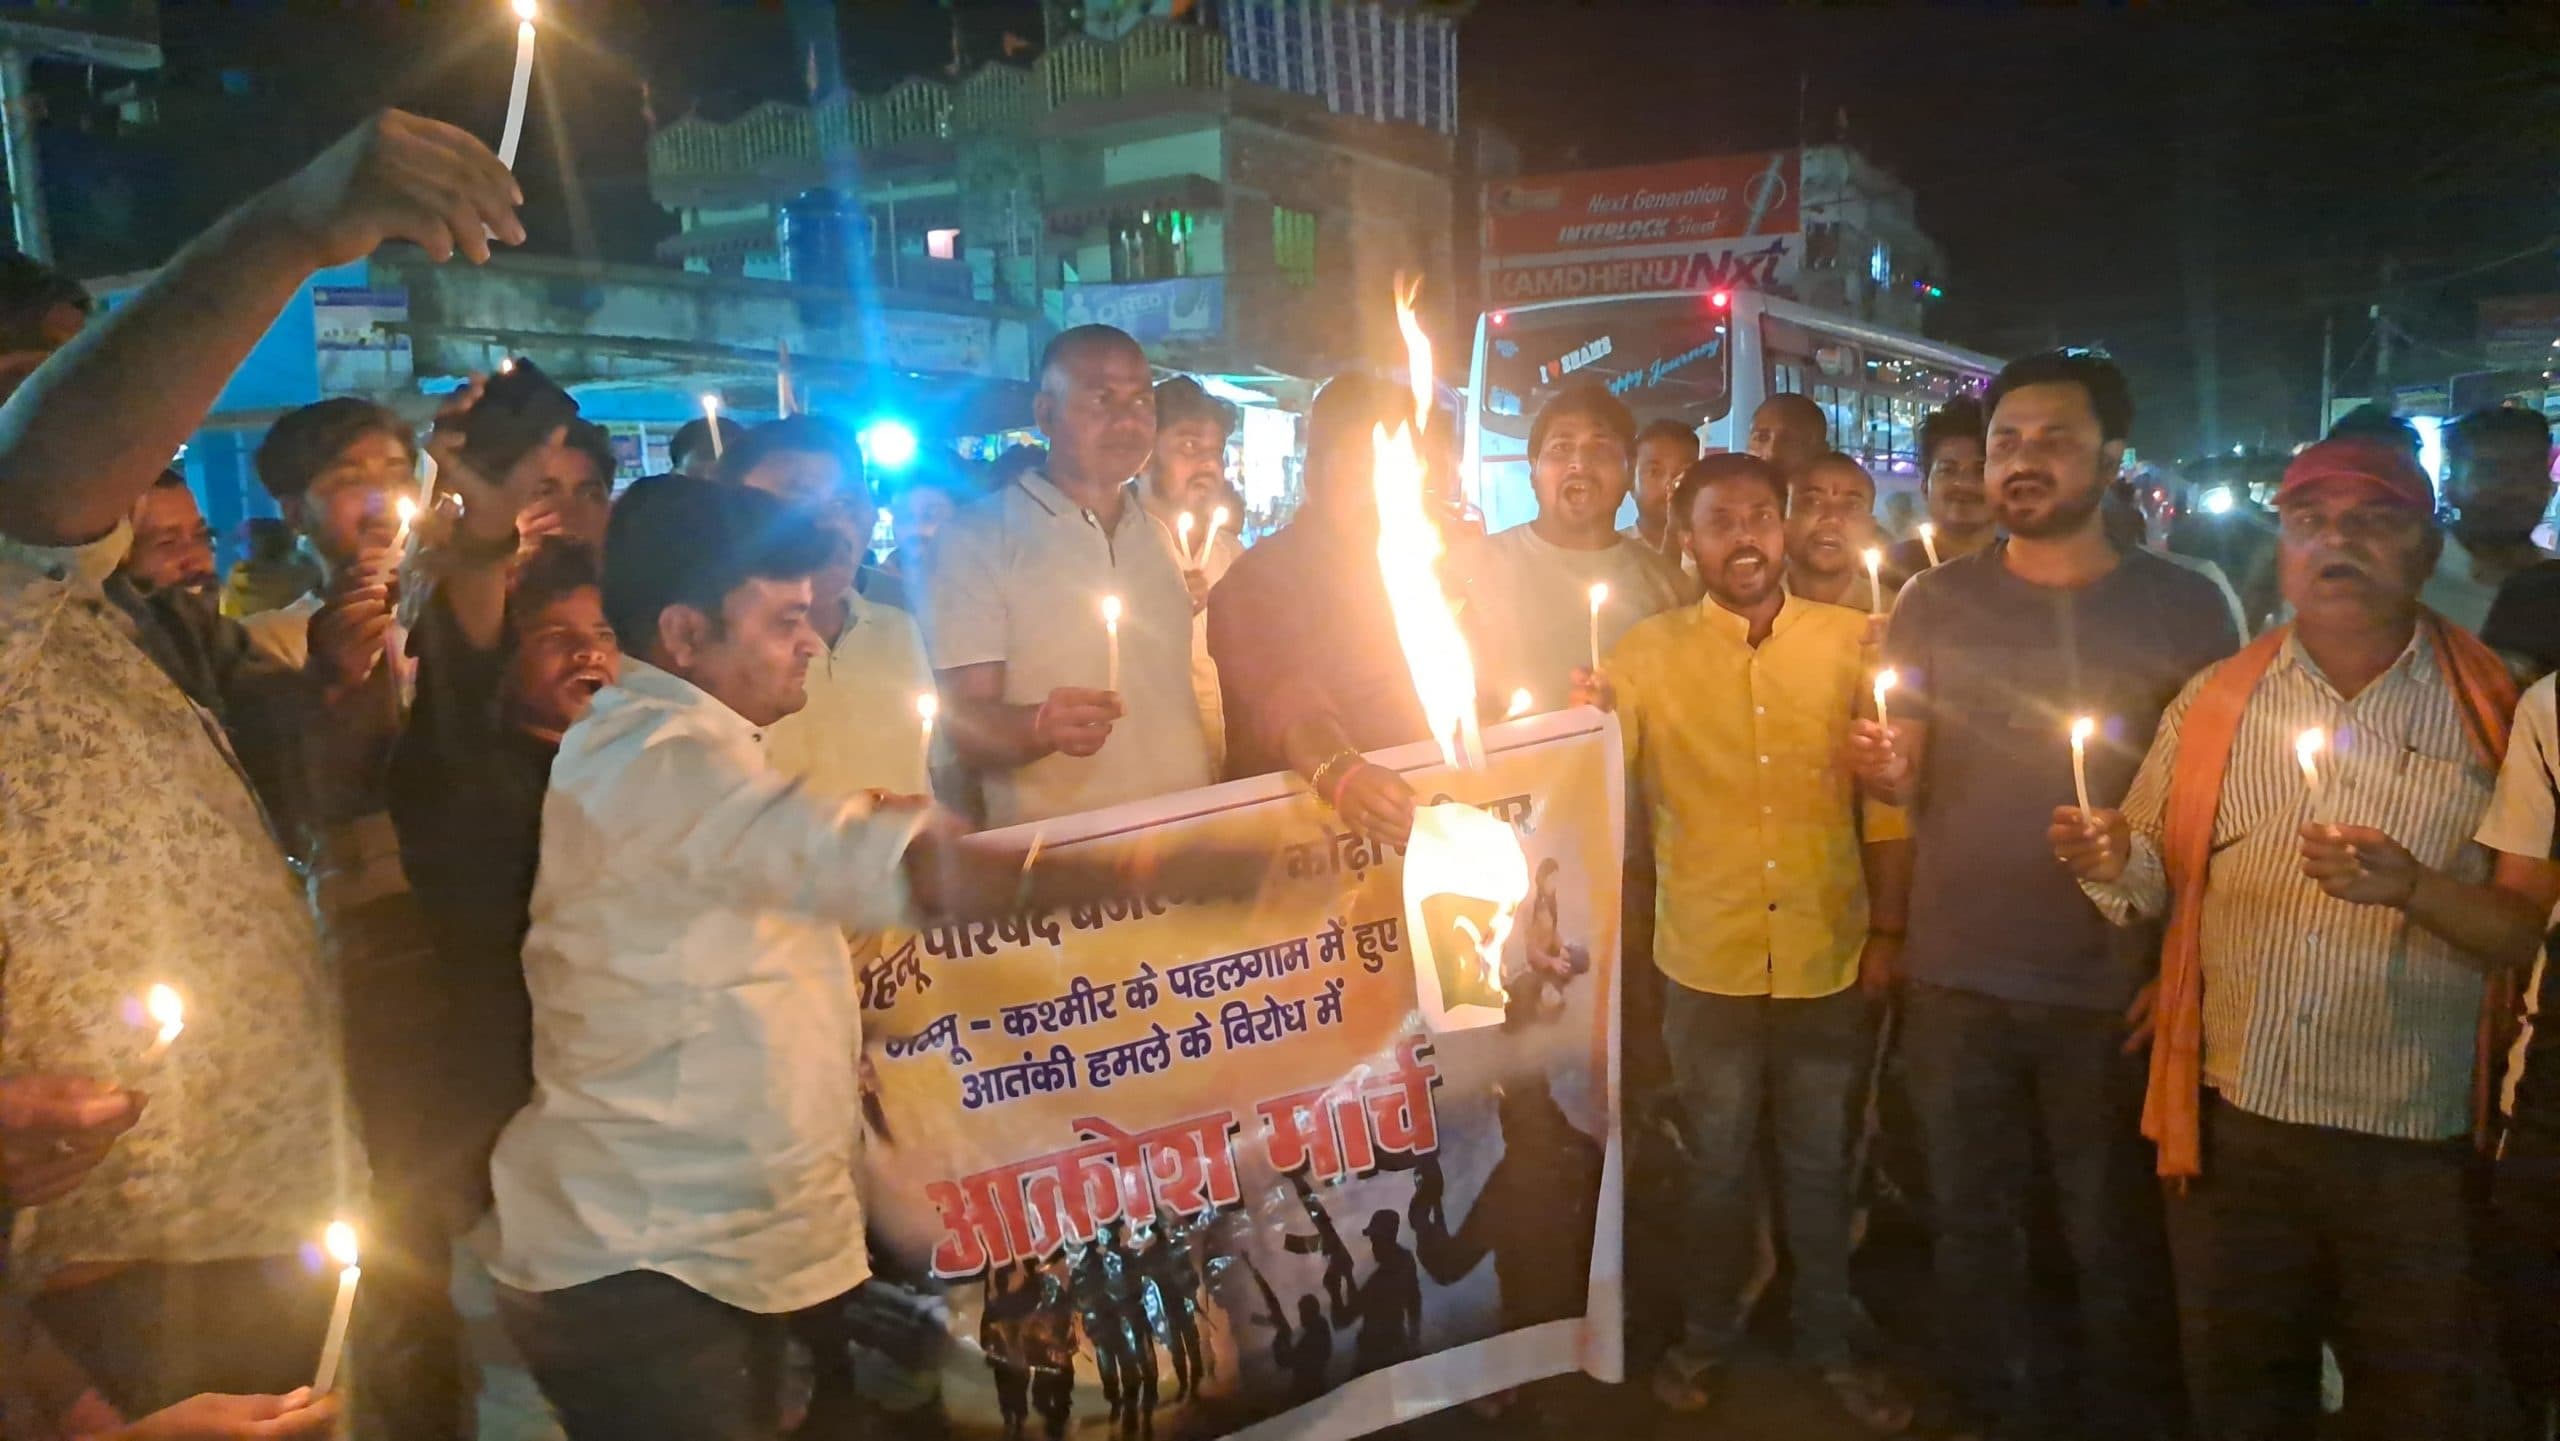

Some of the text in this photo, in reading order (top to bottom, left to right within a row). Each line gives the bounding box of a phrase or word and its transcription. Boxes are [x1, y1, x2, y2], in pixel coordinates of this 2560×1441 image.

[1556, 217, 1671, 244] INTERLOCK
[1632, 182, 1728, 210] Generation
[1000, 976, 1117, 1036] कश्मीर
[1123, 961, 1159, 1010] के
[1167, 937, 1310, 999] पहलगाम
[1316, 916, 1347, 963] में
[1352, 917, 1400, 974] हुए
[962, 977, 1345, 1110] आतंकी हमले के विरोध में
[925, 1034, 1438, 1280] आक्रोश मार्च
